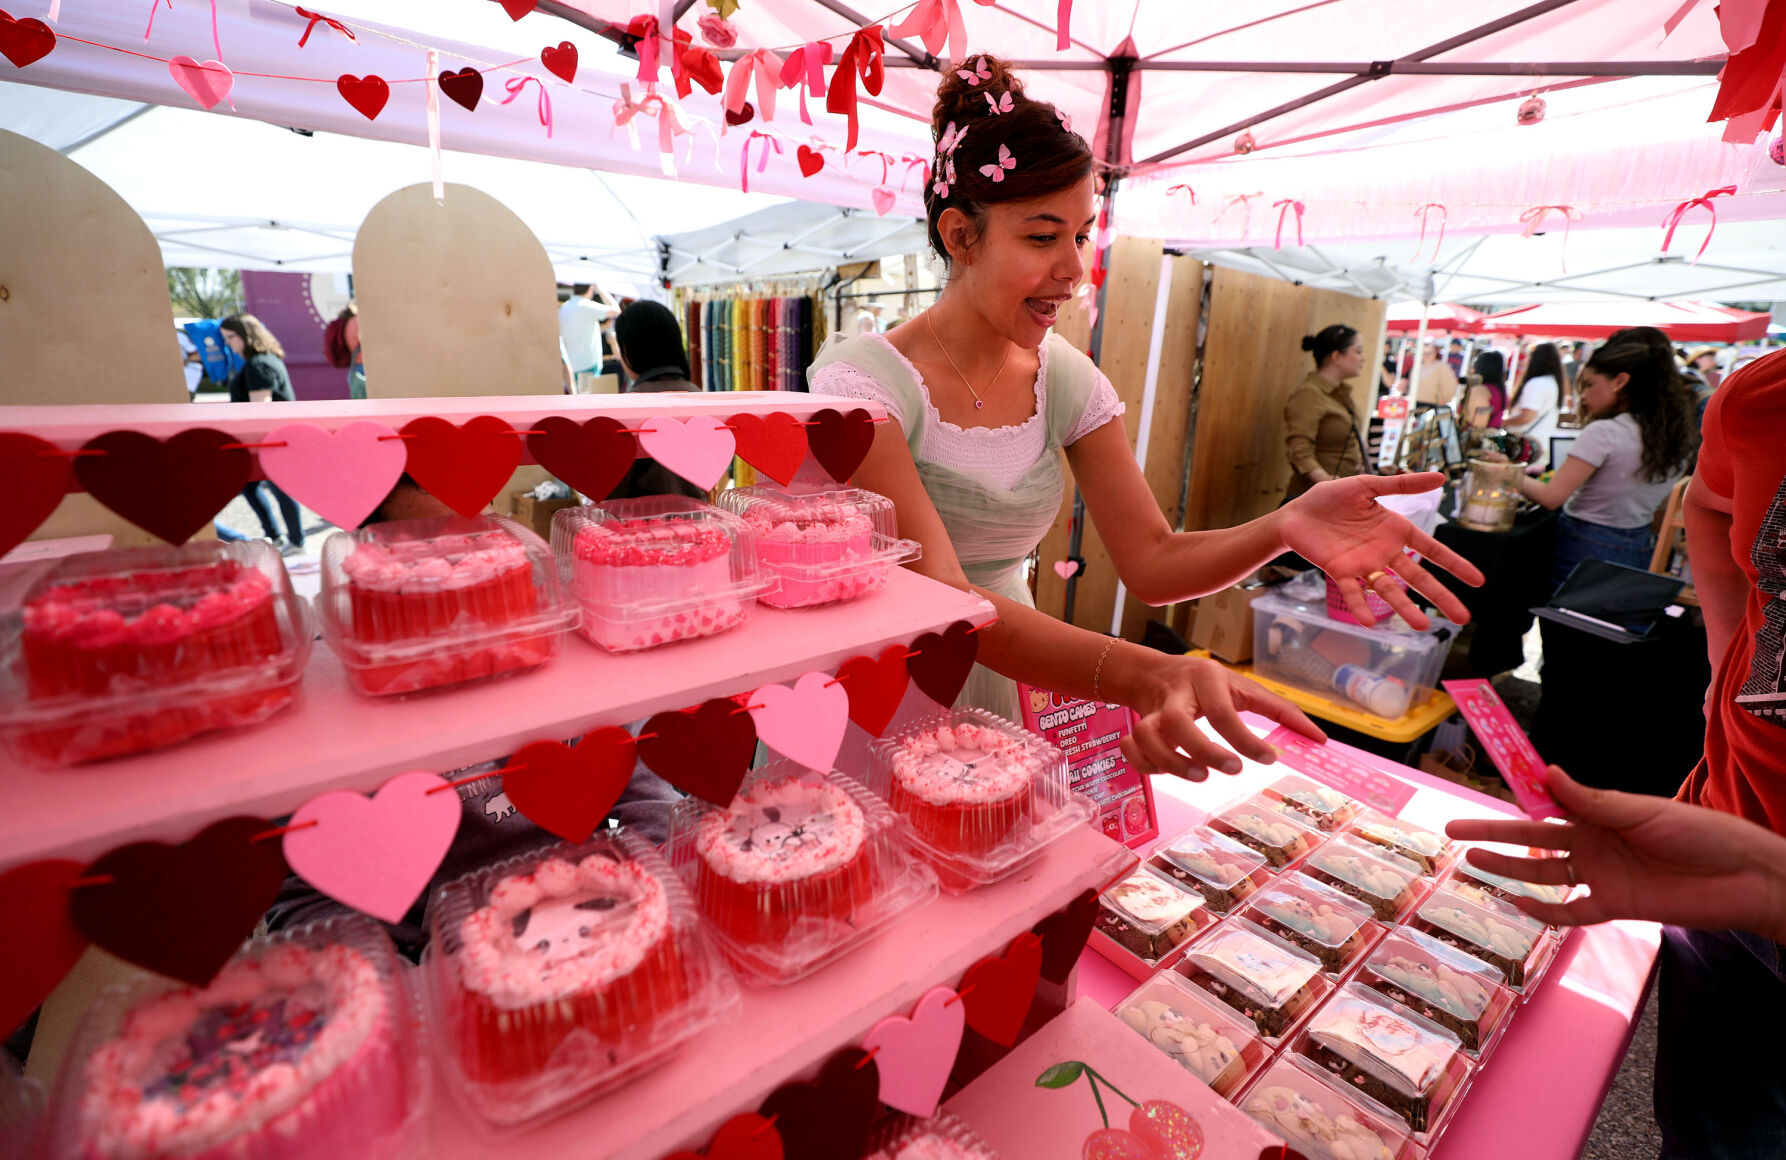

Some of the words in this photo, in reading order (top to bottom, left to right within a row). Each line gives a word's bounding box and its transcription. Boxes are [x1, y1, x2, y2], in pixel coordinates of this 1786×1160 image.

[1039, 709, 1069, 731] BENTO
[1069, 701, 1096, 721] CAKES
[1058, 722, 1088, 738] FUNFETTI
[1060, 736, 1077, 748] OREO
[1081, 731, 1121, 751] STRAWBERRY
[1081, 755, 1116, 779] COOKIES
[1100, 768, 1126, 782] CHOCOLATE
